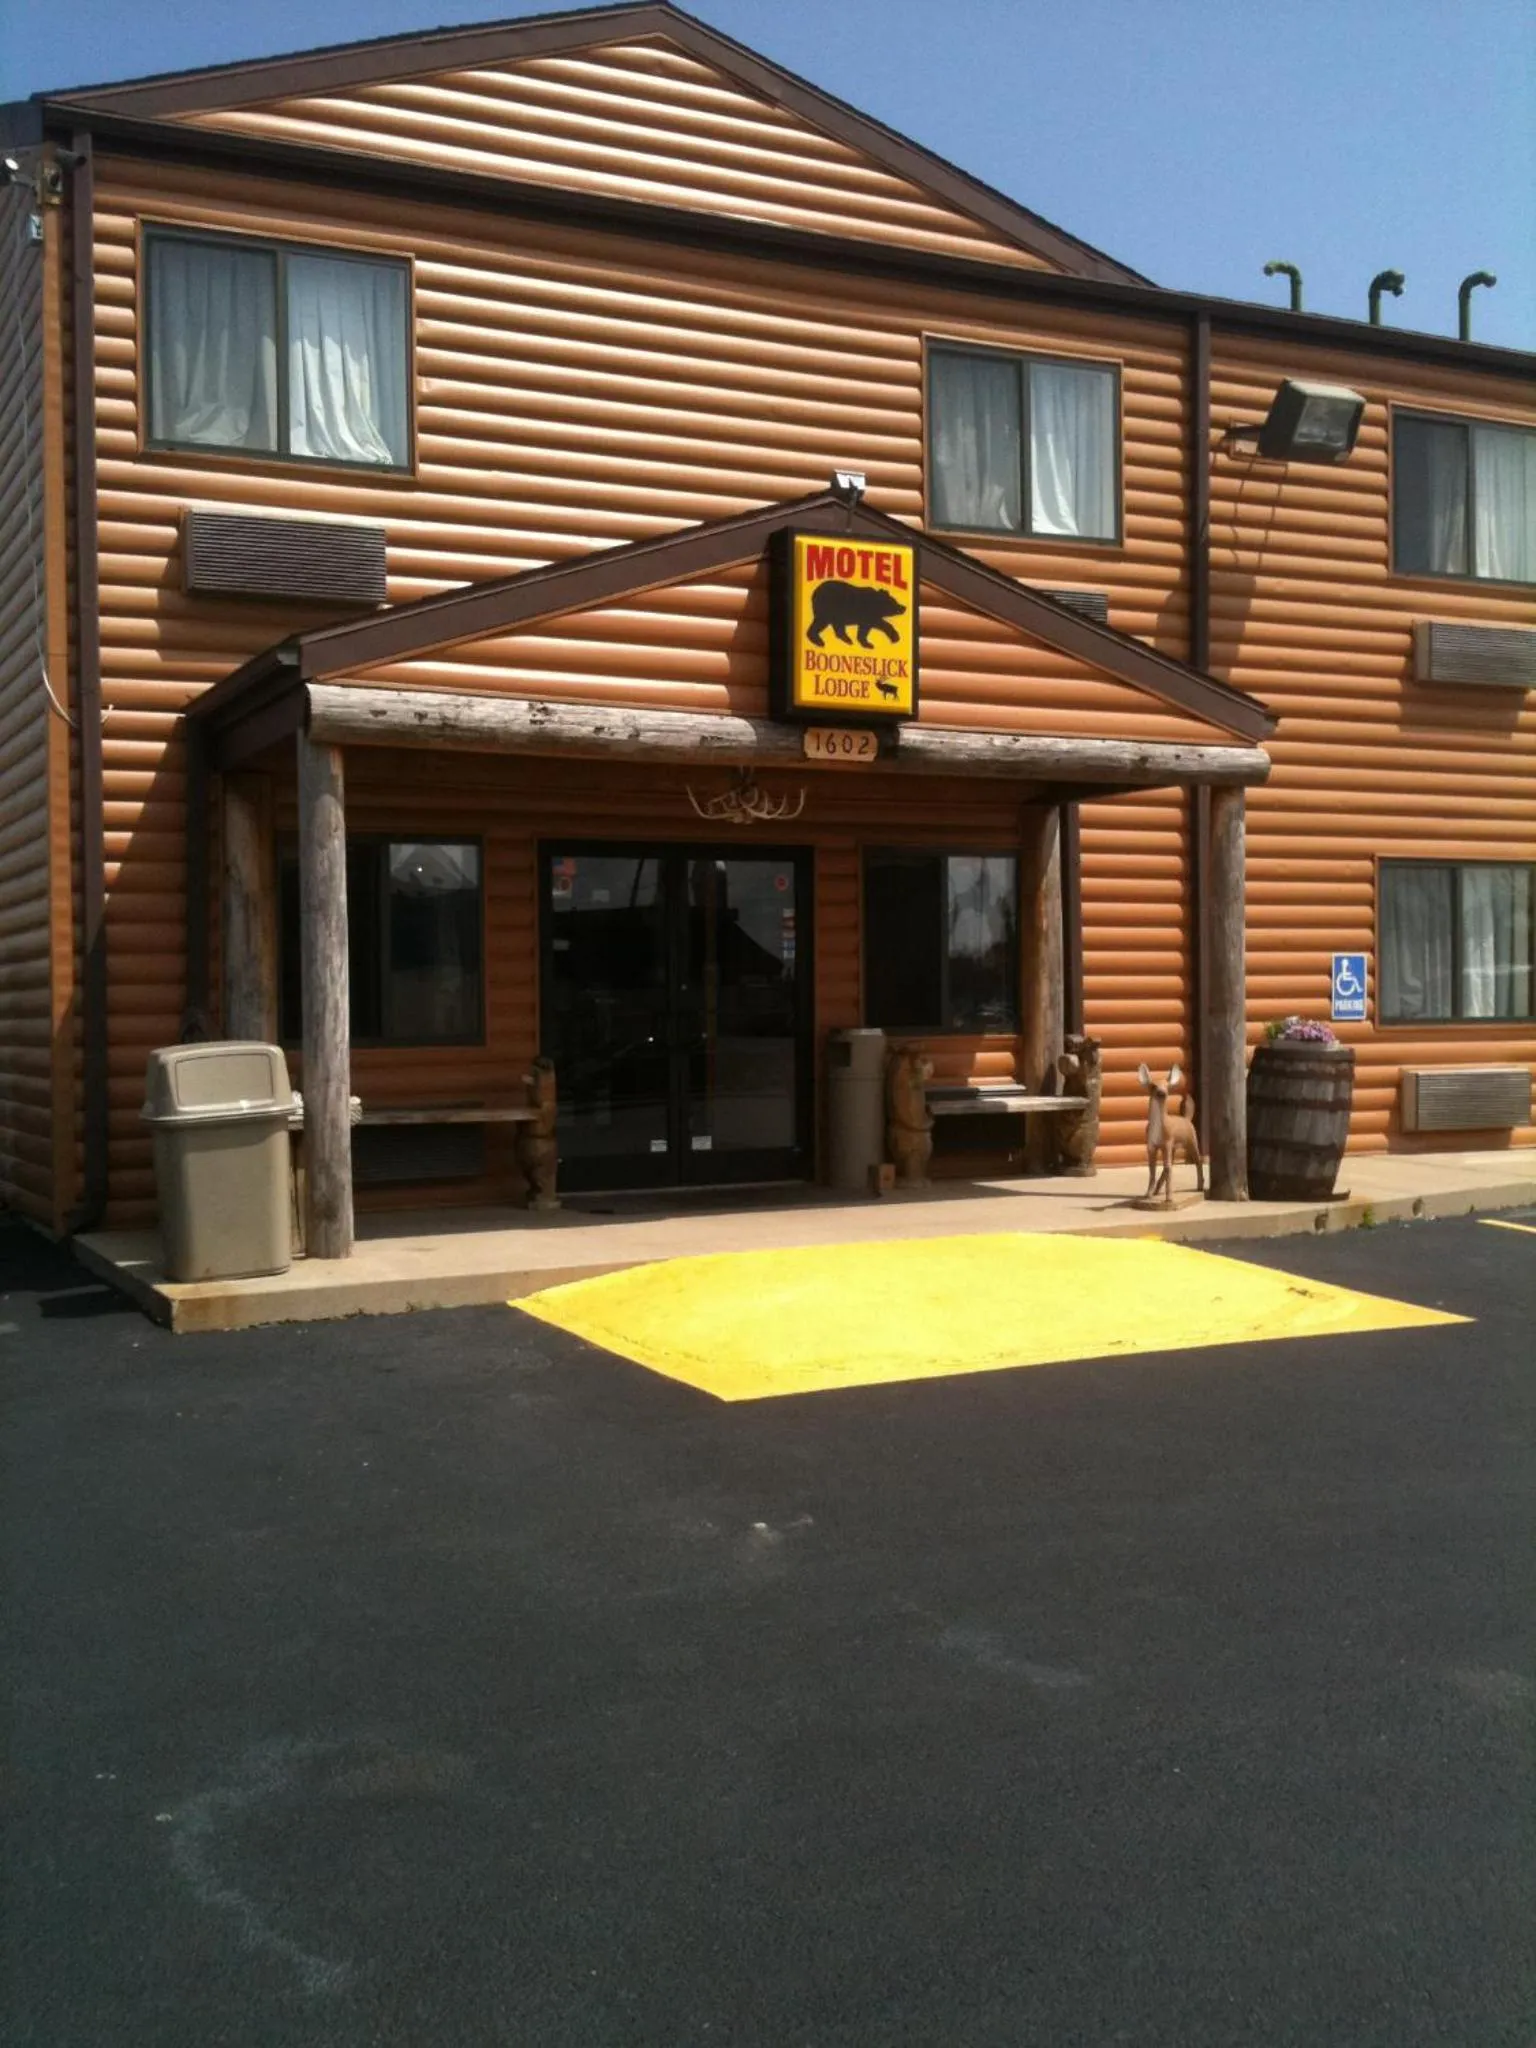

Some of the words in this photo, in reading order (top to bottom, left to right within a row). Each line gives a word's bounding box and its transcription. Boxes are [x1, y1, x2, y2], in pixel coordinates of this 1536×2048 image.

[806, 544, 908, 590] MOTEL
[805, 650, 908, 677] BOONESLICK
[814, 674, 870, 698] LODGE
[814, 732, 870, 755] 1602
